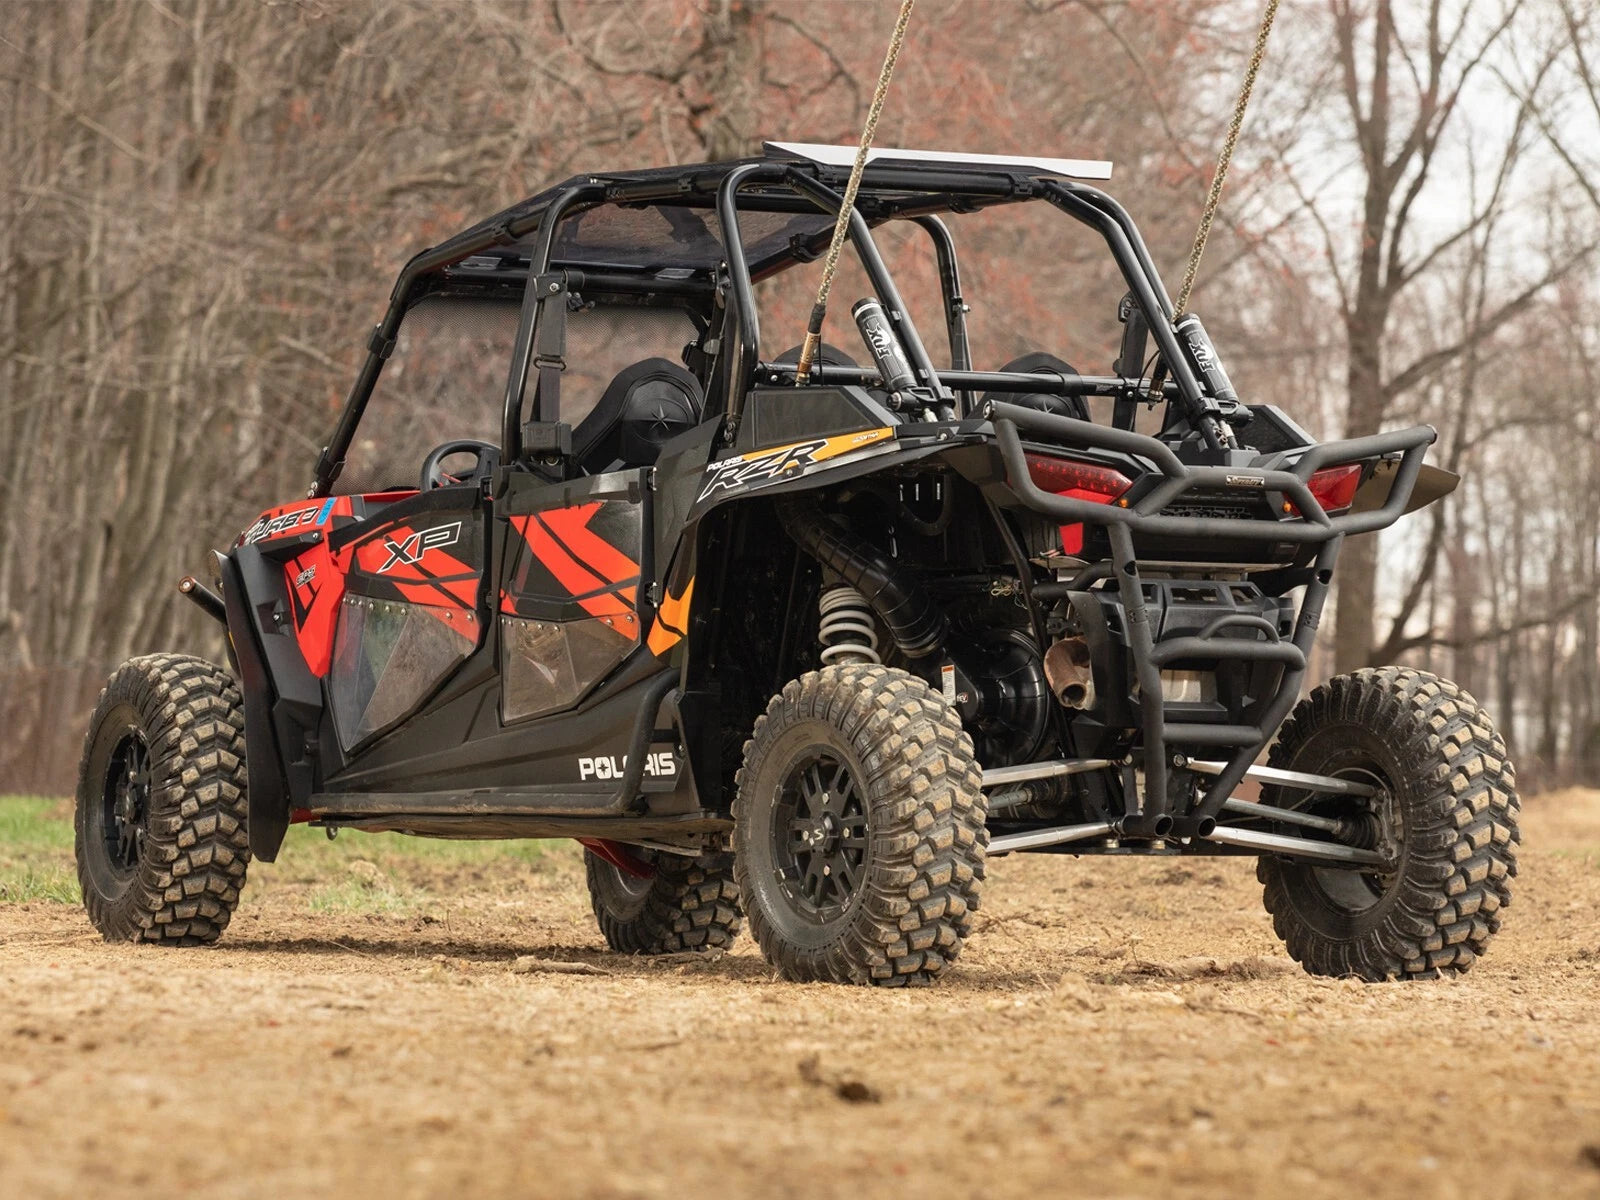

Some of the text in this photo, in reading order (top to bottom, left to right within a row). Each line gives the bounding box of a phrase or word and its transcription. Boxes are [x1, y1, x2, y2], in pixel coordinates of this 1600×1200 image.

[696, 437, 830, 504] RZR
[706, 455, 743, 473] POLARIS
[376, 521, 462, 574] XP
[578, 752, 676, 781] POLRIS
